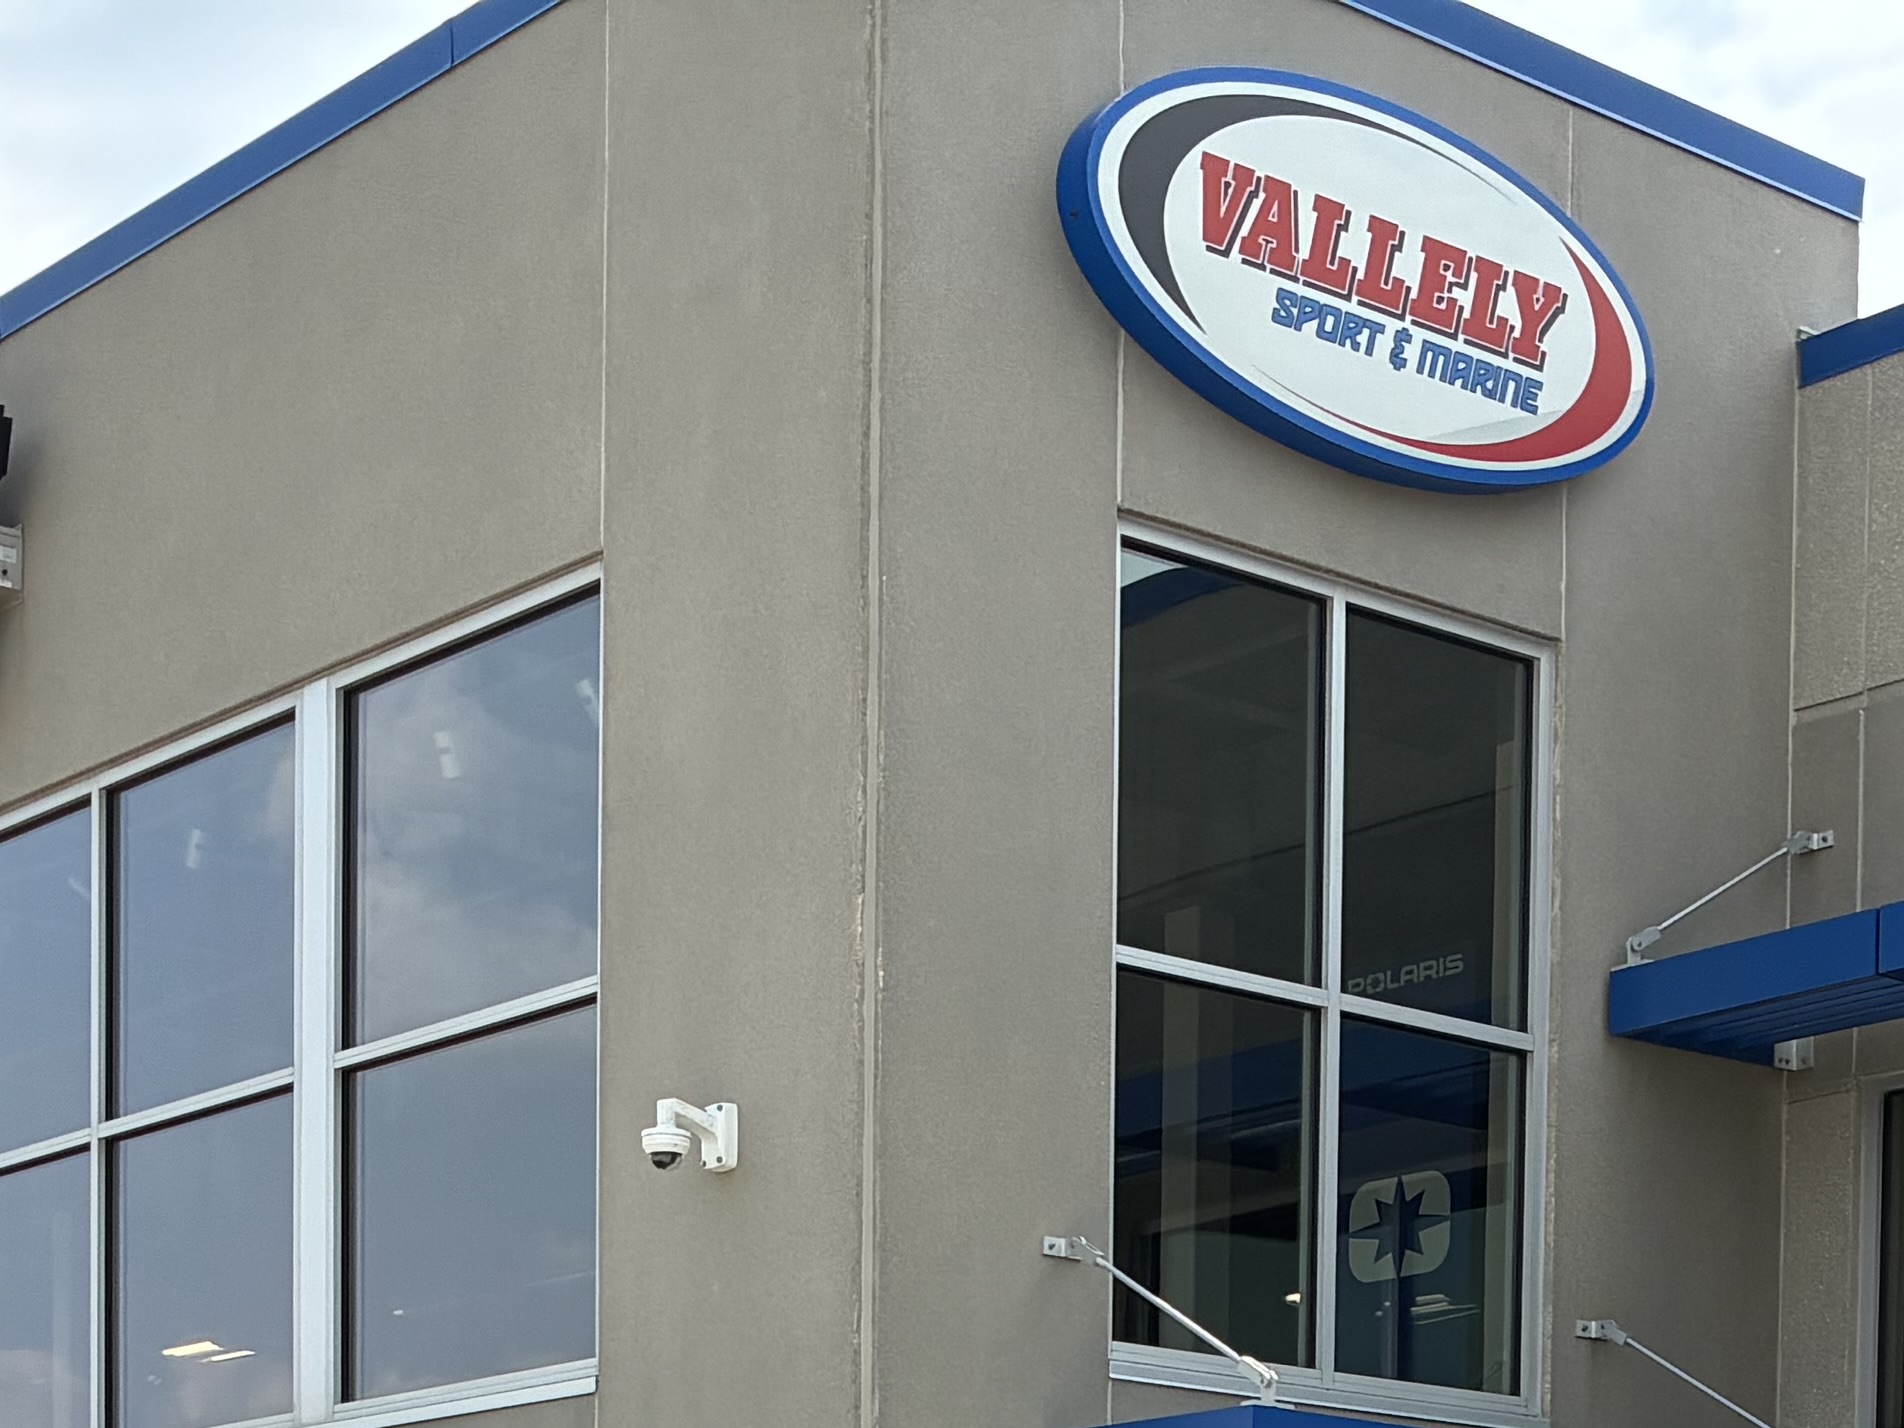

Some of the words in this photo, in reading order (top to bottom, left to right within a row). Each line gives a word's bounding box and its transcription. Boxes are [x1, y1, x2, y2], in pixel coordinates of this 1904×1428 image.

[1199, 150, 1569, 372] VALLELY
[1271, 287, 1386, 356] SPORT
[1389, 327, 1409, 372] &
[1416, 338, 1544, 415] MARINE
[1346, 953, 1465, 995] POLARIS
